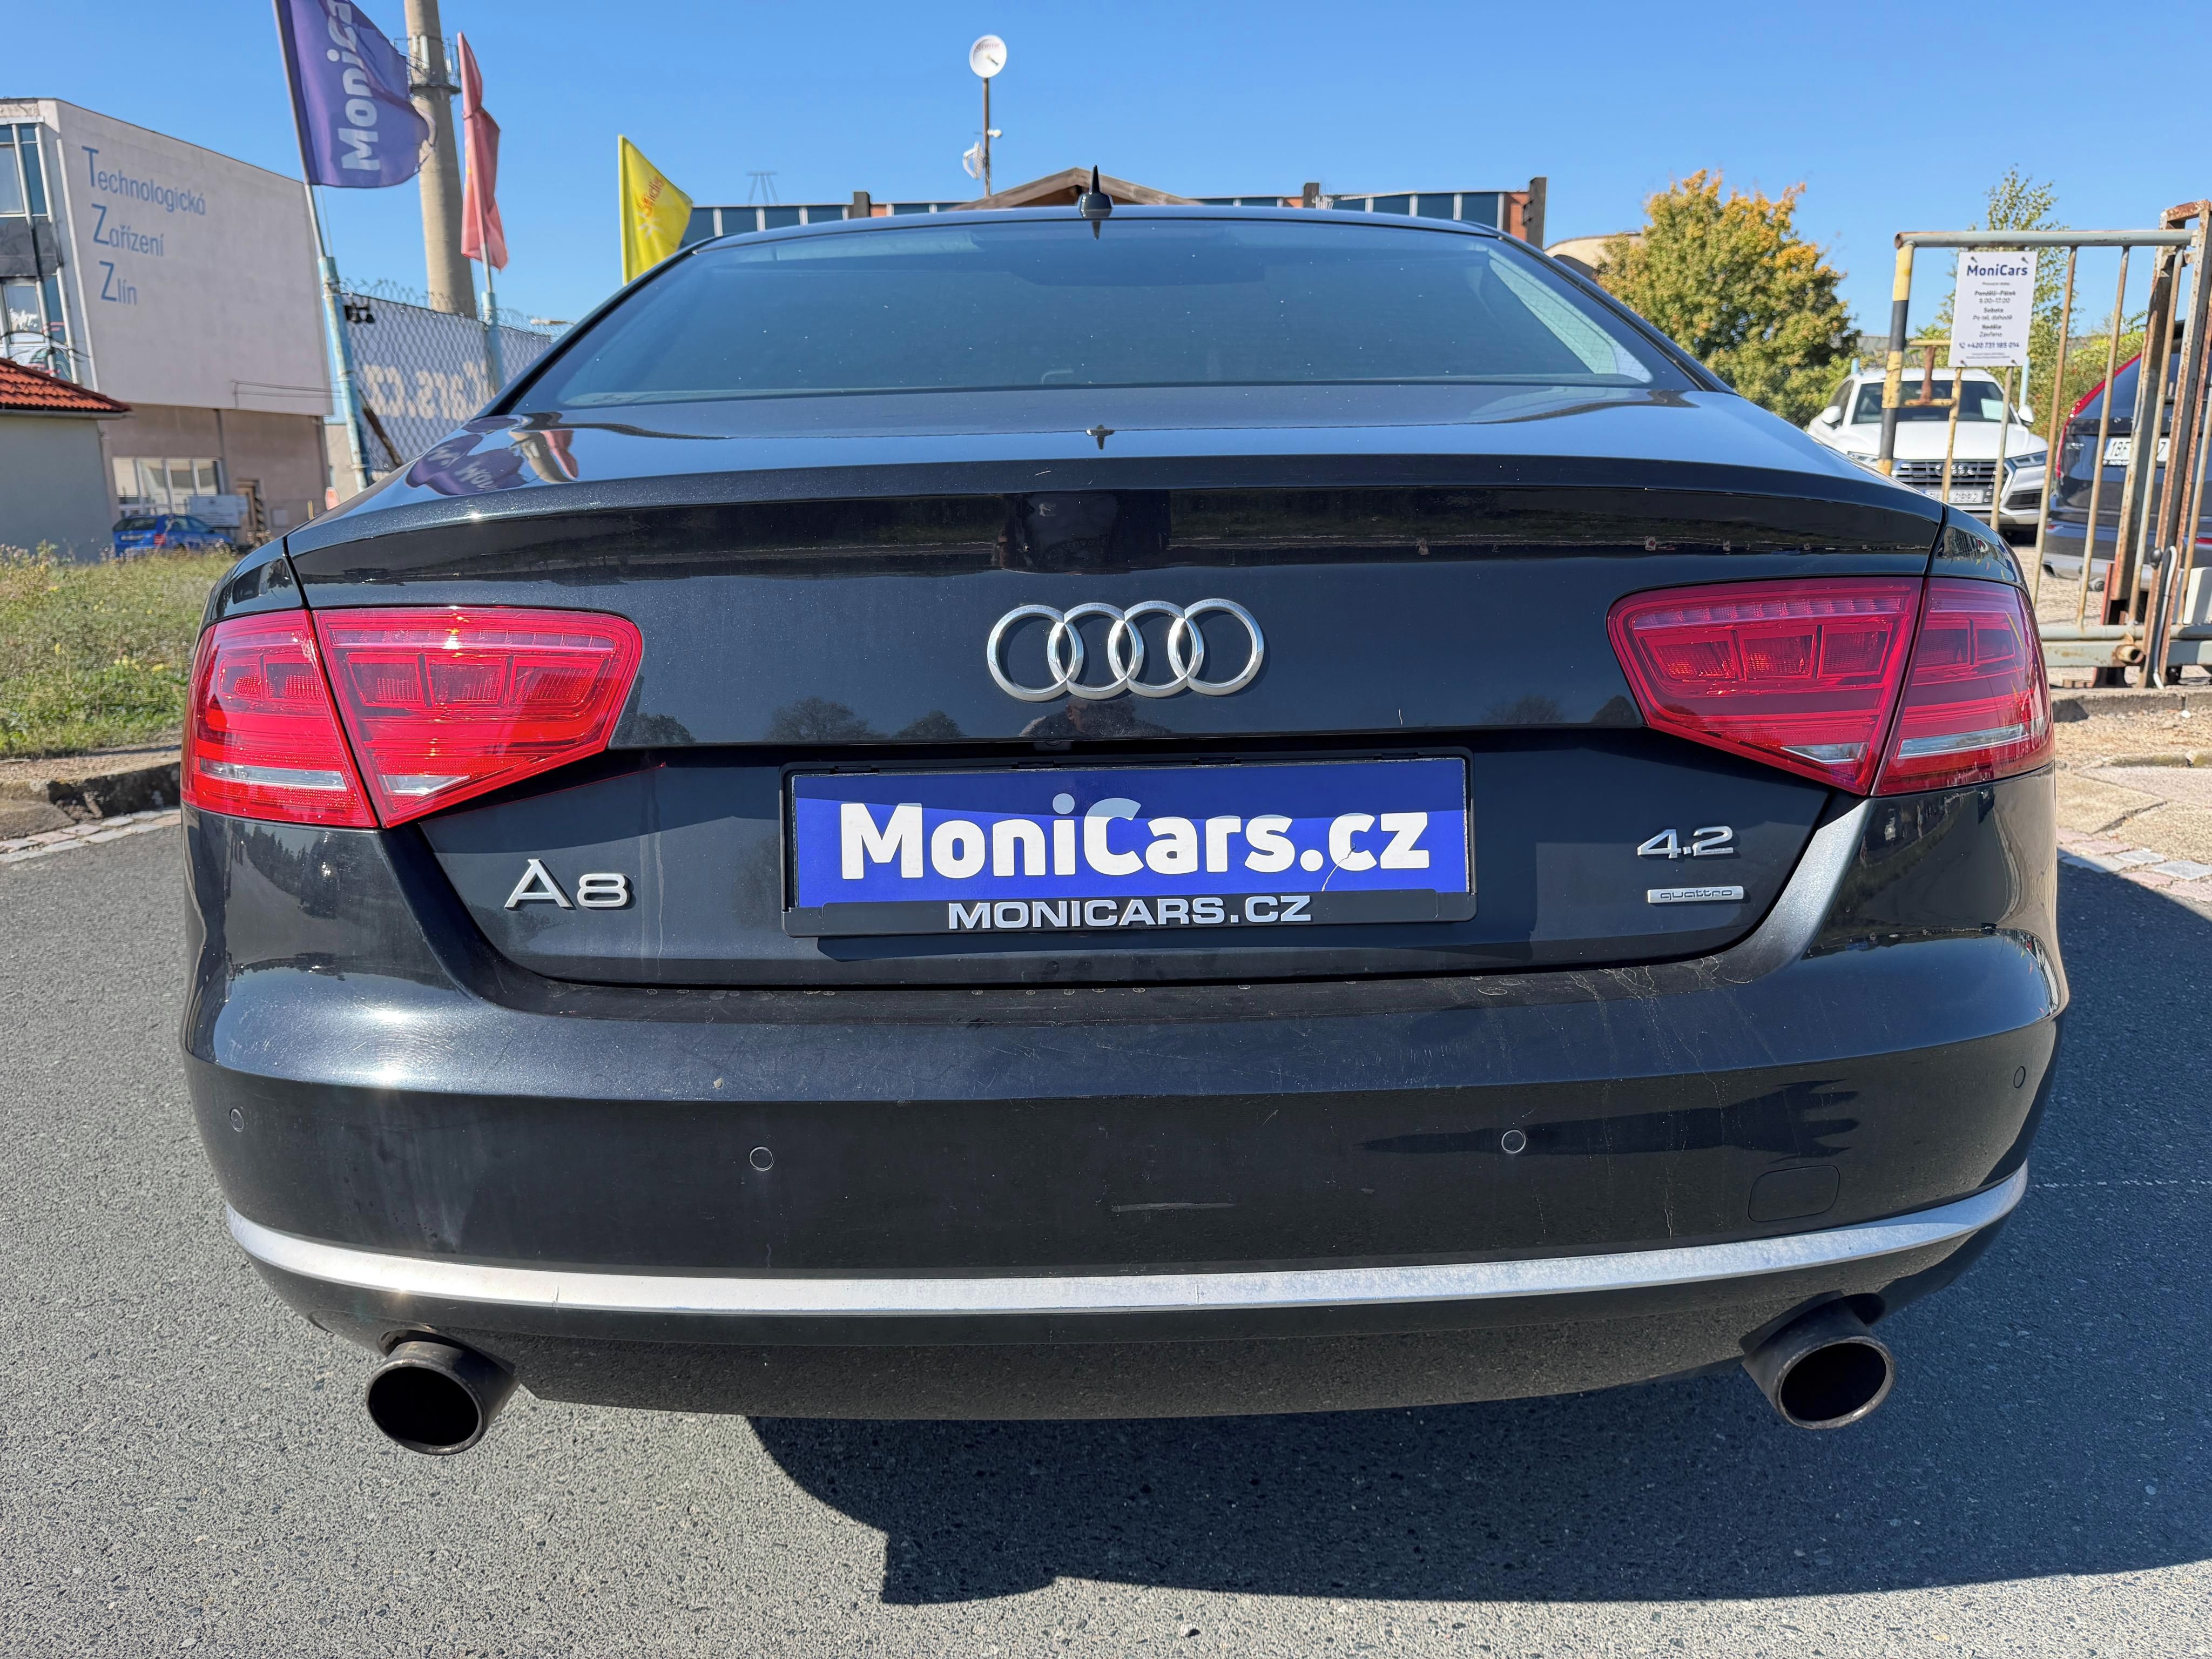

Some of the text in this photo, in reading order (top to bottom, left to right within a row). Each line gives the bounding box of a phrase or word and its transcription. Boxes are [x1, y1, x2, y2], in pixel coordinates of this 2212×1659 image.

[82, 146, 206, 216] Technologická
[91, 203, 164, 257] Zařízení
[99, 261, 138, 305] Zlín
[1966, 264, 2028, 276] MoniCars
[840, 793, 1429, 880] MoniCars.cz
[1637, 826, 1734, 859] 4.2
[504, 859, 628, 908] A8
[1660, 889, 1733, 901] quattro
[947, 895, 1312, 930] MONICARS.CZ
